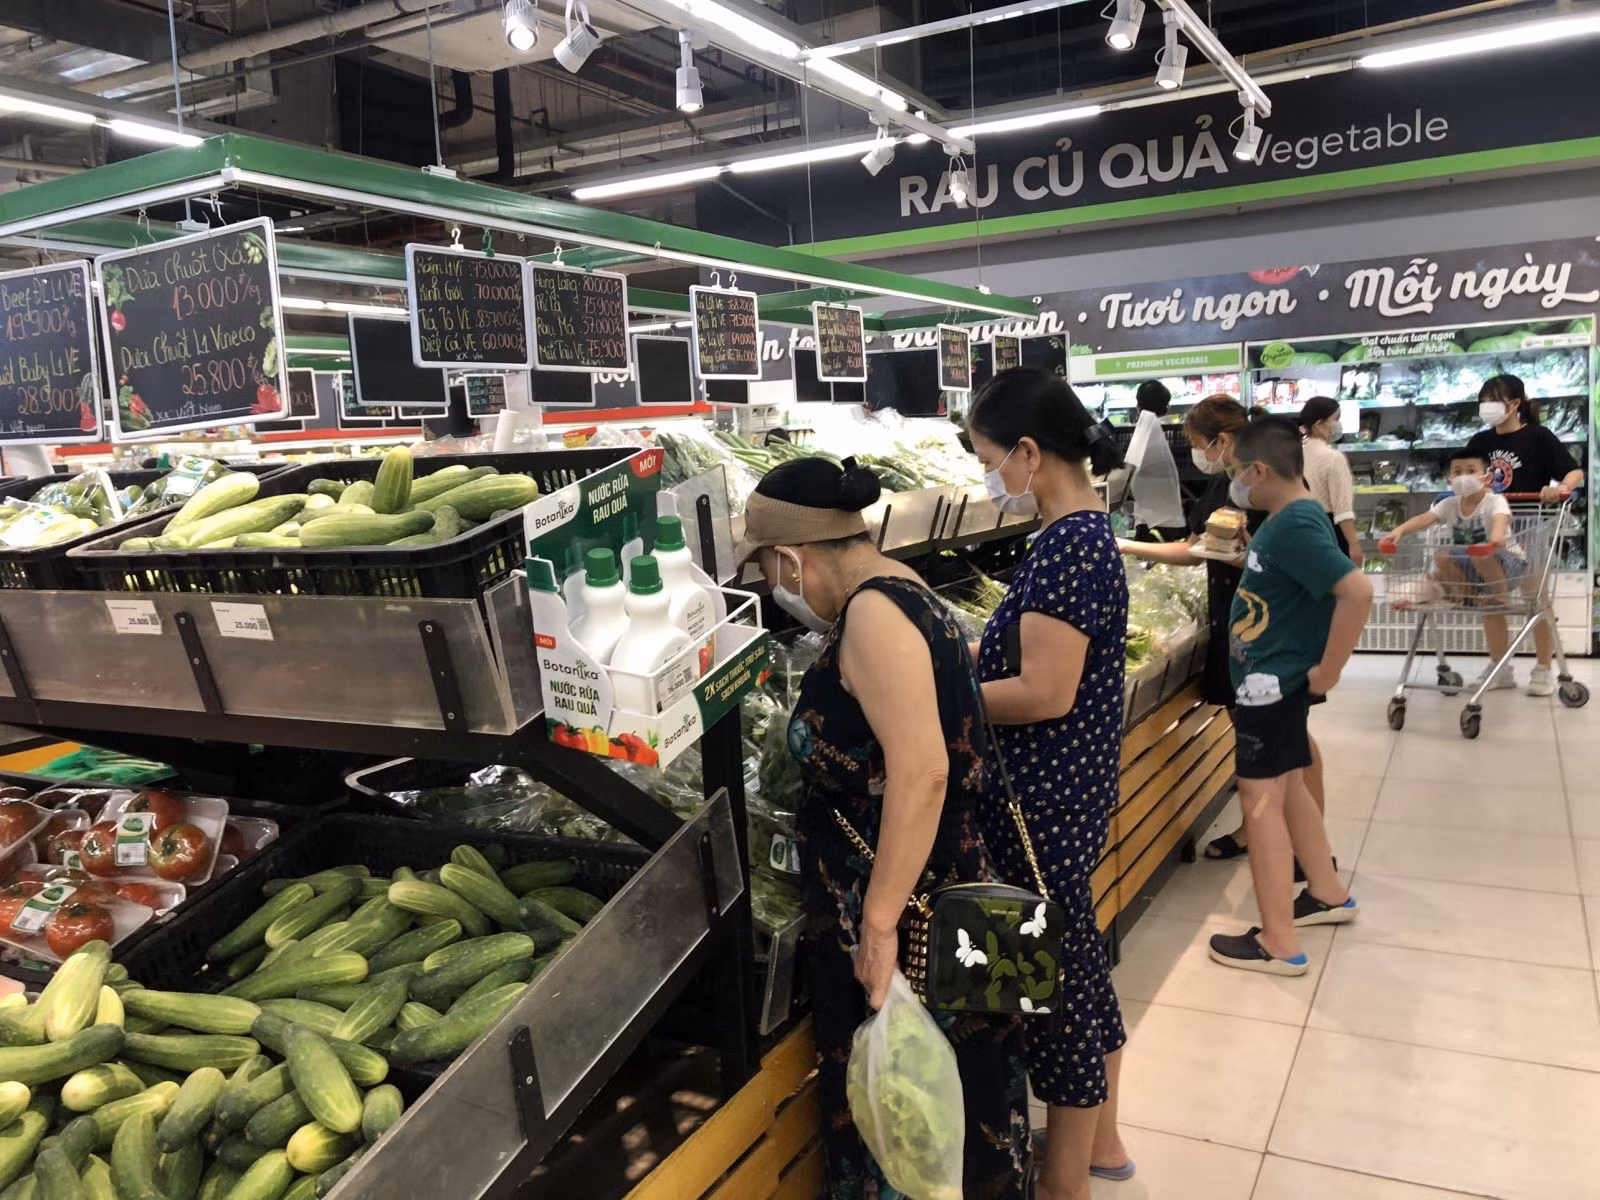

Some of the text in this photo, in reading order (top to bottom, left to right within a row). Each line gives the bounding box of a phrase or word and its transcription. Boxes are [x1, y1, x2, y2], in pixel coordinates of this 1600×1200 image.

[900, 163, 999, 216] RAU
[1012, 137, 1083, 201] CỦ
[1099, 113, 1230, 188] QUẢ
[1099, 288, 1184, 329] Tươi
[1191, 287, 1297, 330] ngon
[1344, 258, 1441, 316] Mỗi
[1449, 253, 1600, 309] ngày
[1127, 355, 1209, 369] PREMIUM VEGETABLE
[639, 454, 656, 473] MỚI
[588, 473, 629, 506] NƯỚC RỬA
[535, 504, 574, 529] Botanika
[593, 493, 628, 524] RAU QUẢ
[543, 659, 598, 680] Botanika
[550, 680, 600, 702] NƯỚC RỬA
[704, 681, 716, 701] 2X
[554, 696, 598, 716] RAU QUẢ
[664, 715, 697, 749] Botanika
